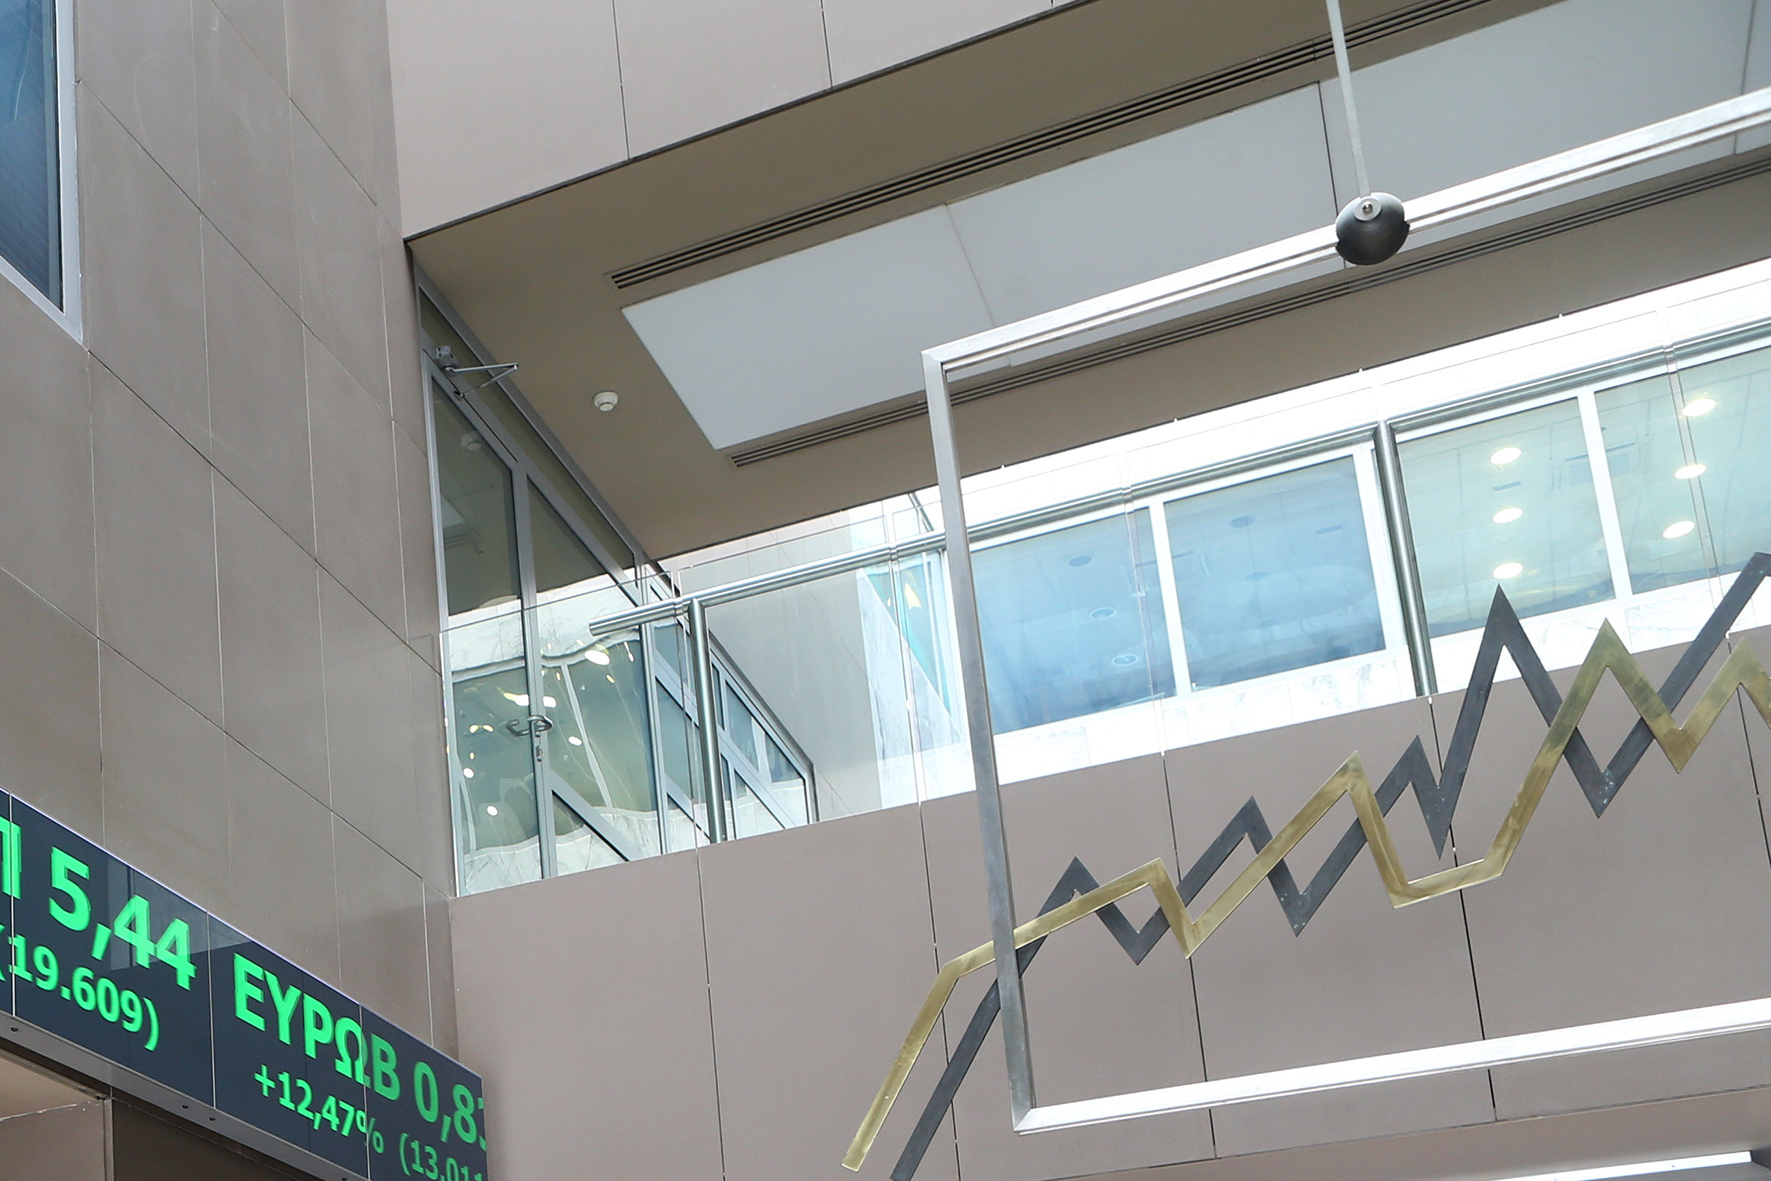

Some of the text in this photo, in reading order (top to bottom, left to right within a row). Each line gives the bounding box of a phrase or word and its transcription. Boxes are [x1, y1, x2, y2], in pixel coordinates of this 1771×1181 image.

[49, 848, 196, 990] 5,44
[254, 1065, 384, 1153] +12,47%
[414, 1062, 486, 1151] 0,8
